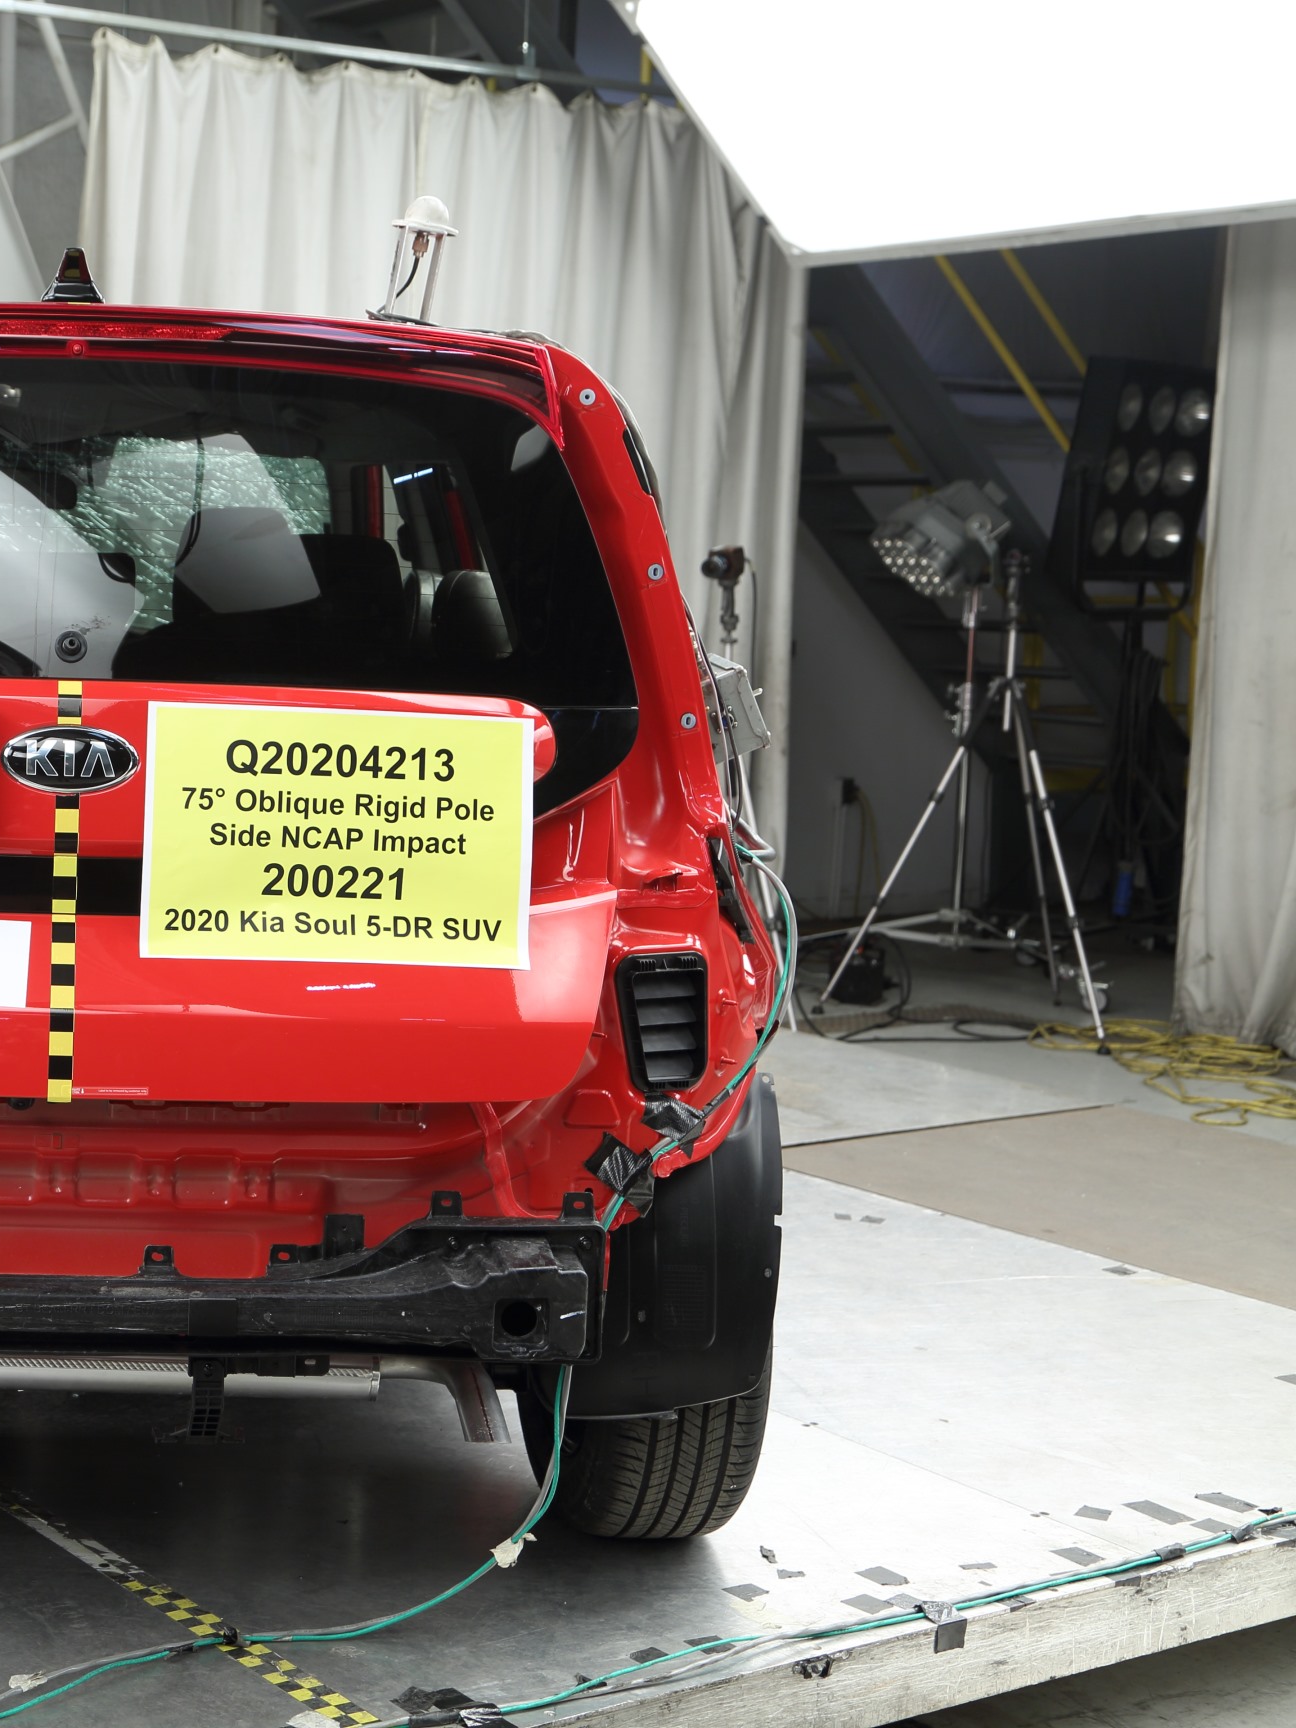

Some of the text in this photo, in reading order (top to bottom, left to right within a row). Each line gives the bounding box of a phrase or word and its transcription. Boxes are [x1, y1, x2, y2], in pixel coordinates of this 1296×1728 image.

[25, 739, 115, 778] KIA
[226, 740, 455, 782] Q20204213
[236, 788, 344, 818] Oblique
[355, 794, 426, 823] Rigid
[436, 797, 495, 822] Pole
[210, 822, 466, 858] Side NCAP Impact
[262, 863, 405, 900] 200221
[164, 908, 502, 942] 2020 Kia Soul 5-DR SUV
